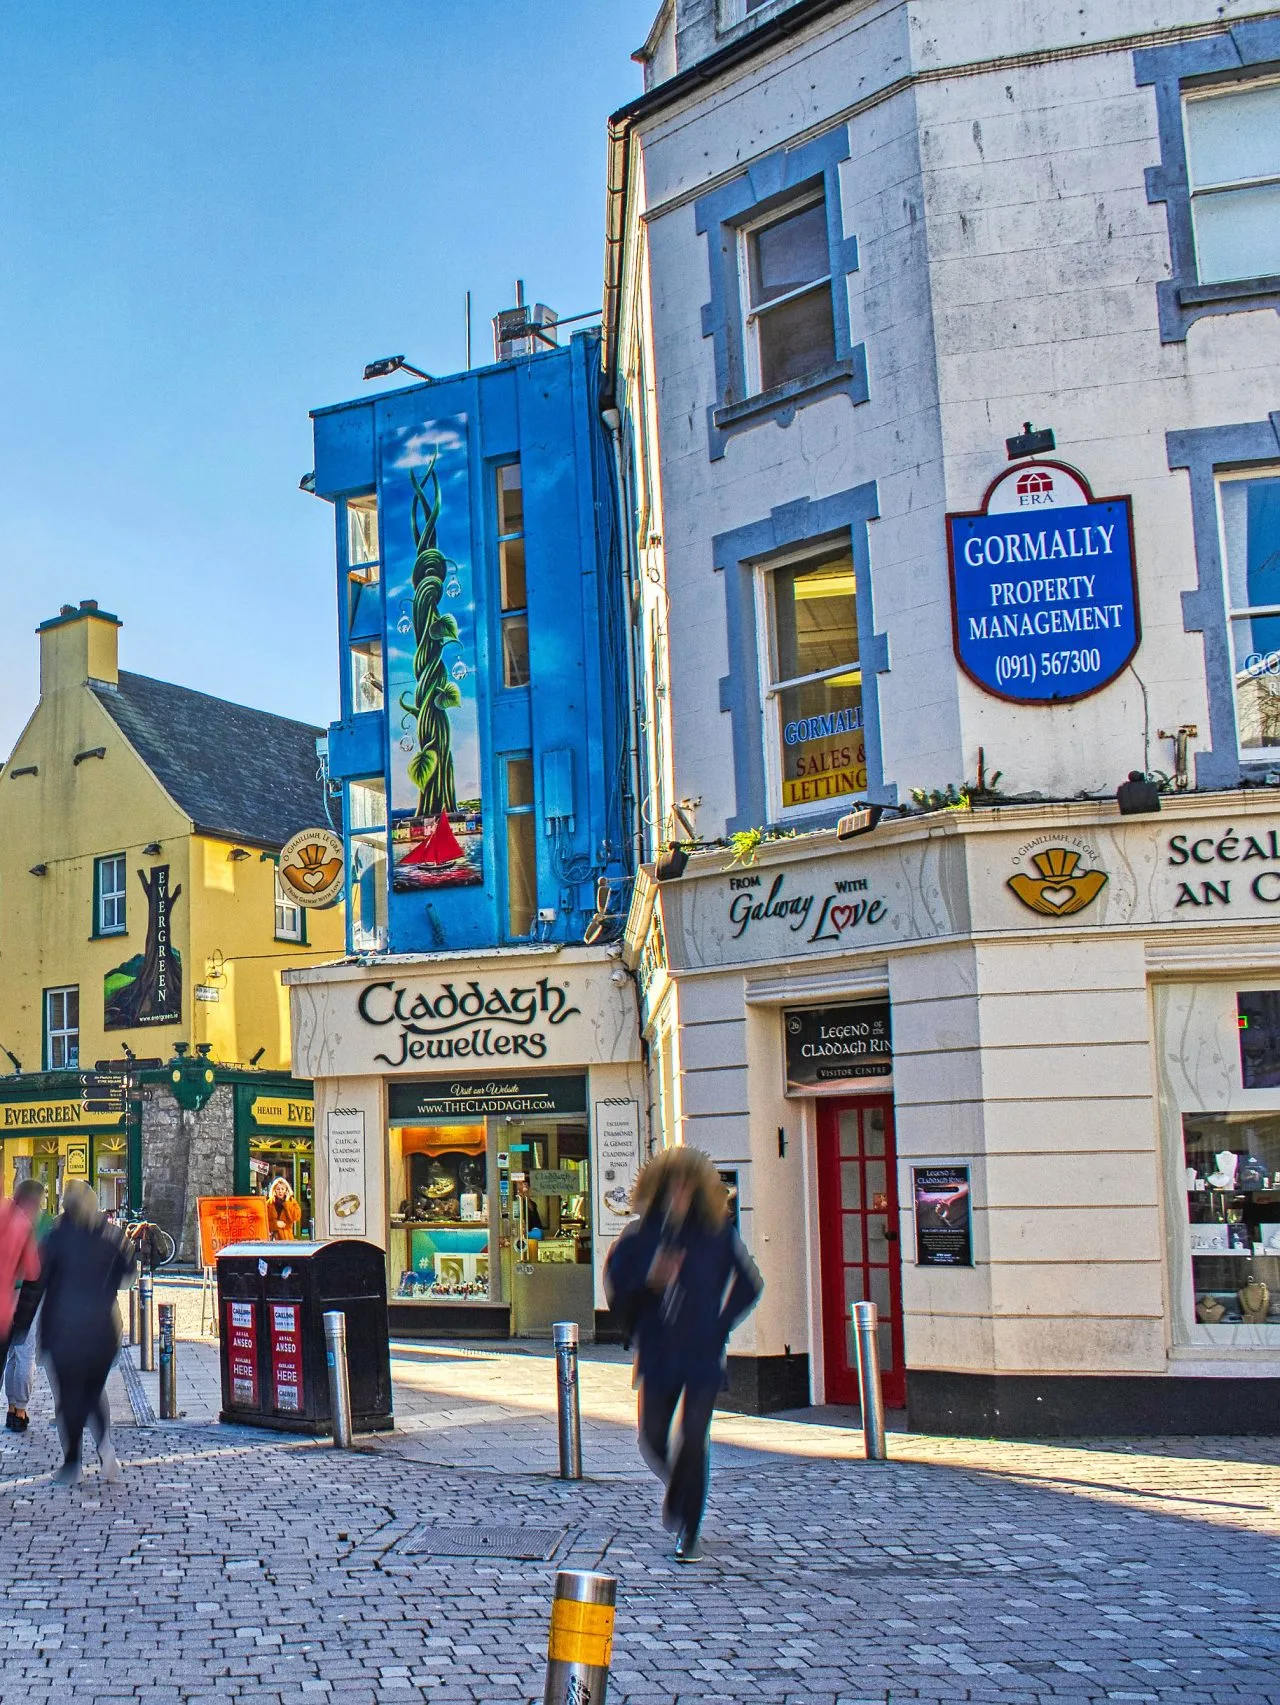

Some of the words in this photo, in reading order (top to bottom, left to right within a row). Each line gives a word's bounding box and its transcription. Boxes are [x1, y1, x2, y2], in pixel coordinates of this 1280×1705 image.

[964, 524, 1115, 567] GORMALLY
[989, 574, 1096, 606] PROPERTY
[968, 604, 1123, 640] MANAGEMENT
[995, 653, 1037, 685] (091)
[1041, 648, 1101, 676] 567300
[784, 706, 864, 745] GORMALL
[796, 746, 851, 777] SALES
[729, 874, 761, 891] FROM
[834, 878, 868, 893] WITH
[1175, 879, 1231, 908] AN
[729, 873, 814, 939] Galway
[157, 871, 167, 1002] EVERGREEN
[357, 976, 582, 1035] Claddagh
[139, 1011, 178, 1023] www.evergreen.ie
[820, 1022, 870, 1039] LEGEND
[373, 1028, 548, 1067] Jewellers
[801, 1040, 867, 1058] CLADDAGH
[870, 1038, 892, 1052] RIN
[820, 1068, 852, 1077] VISITOR
[855, 1066, 886, 1075] CENTRE
[450, 1083, 472, 1097] Visit
[473, 1087, 485, 1095] our
[485, 1082, 519, 1096] Website
[4, 1103, 82, 1126] EVERGREEN
[257, 1106, 282, 1116] HEALTH
[233, 1337, 253, 1349] ANSEO
[276, 1342, 296, 1353] ANSEO
[233, 1364, 253, 1377] HERE
[276, 1370, 297, 1383] HERE
